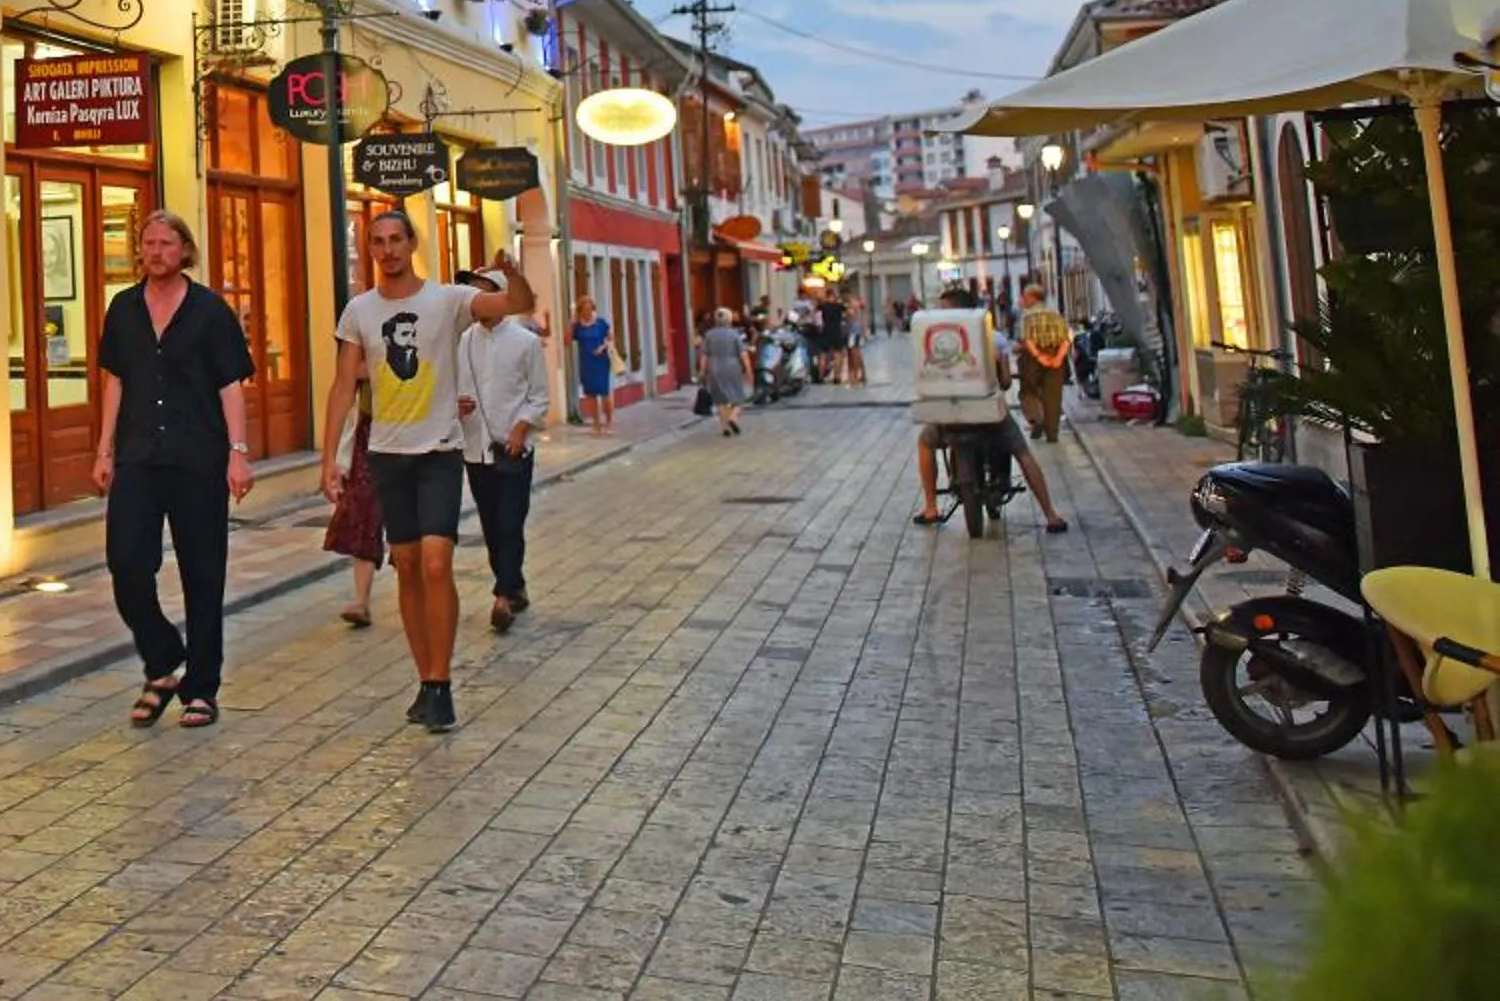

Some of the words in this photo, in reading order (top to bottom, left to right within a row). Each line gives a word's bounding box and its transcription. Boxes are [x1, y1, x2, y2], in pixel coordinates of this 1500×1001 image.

[23, 81, 46, 102] ART
[49, 78, 89, 101] GALERI
[91, 76, 143, 98] PIKTURA
[116, 100, 140, 120] LUX
